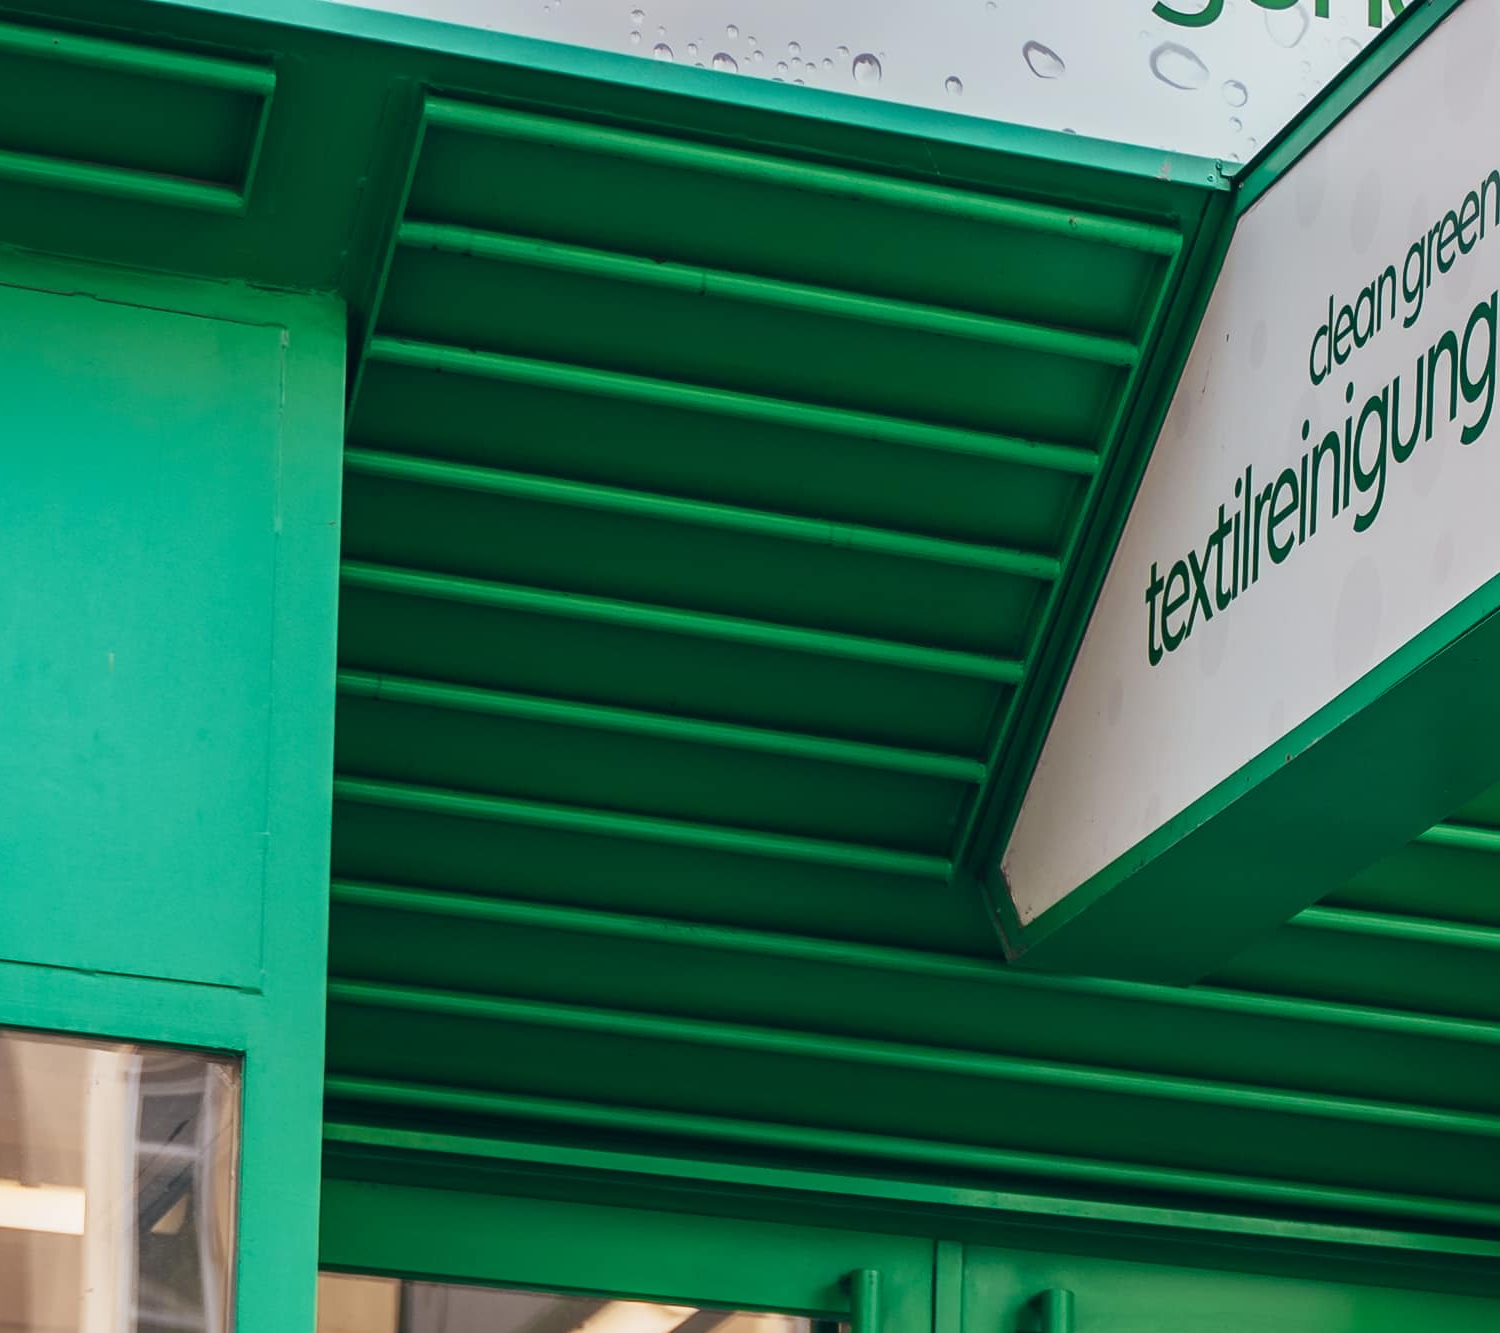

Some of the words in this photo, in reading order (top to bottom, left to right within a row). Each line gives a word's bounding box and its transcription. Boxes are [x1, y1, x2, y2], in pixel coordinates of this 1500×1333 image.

[1308, 264, 1397, 386] clean
[1402, 168, 1500, 329] green
[1145, 289, 1499, 667] textilreinigung
